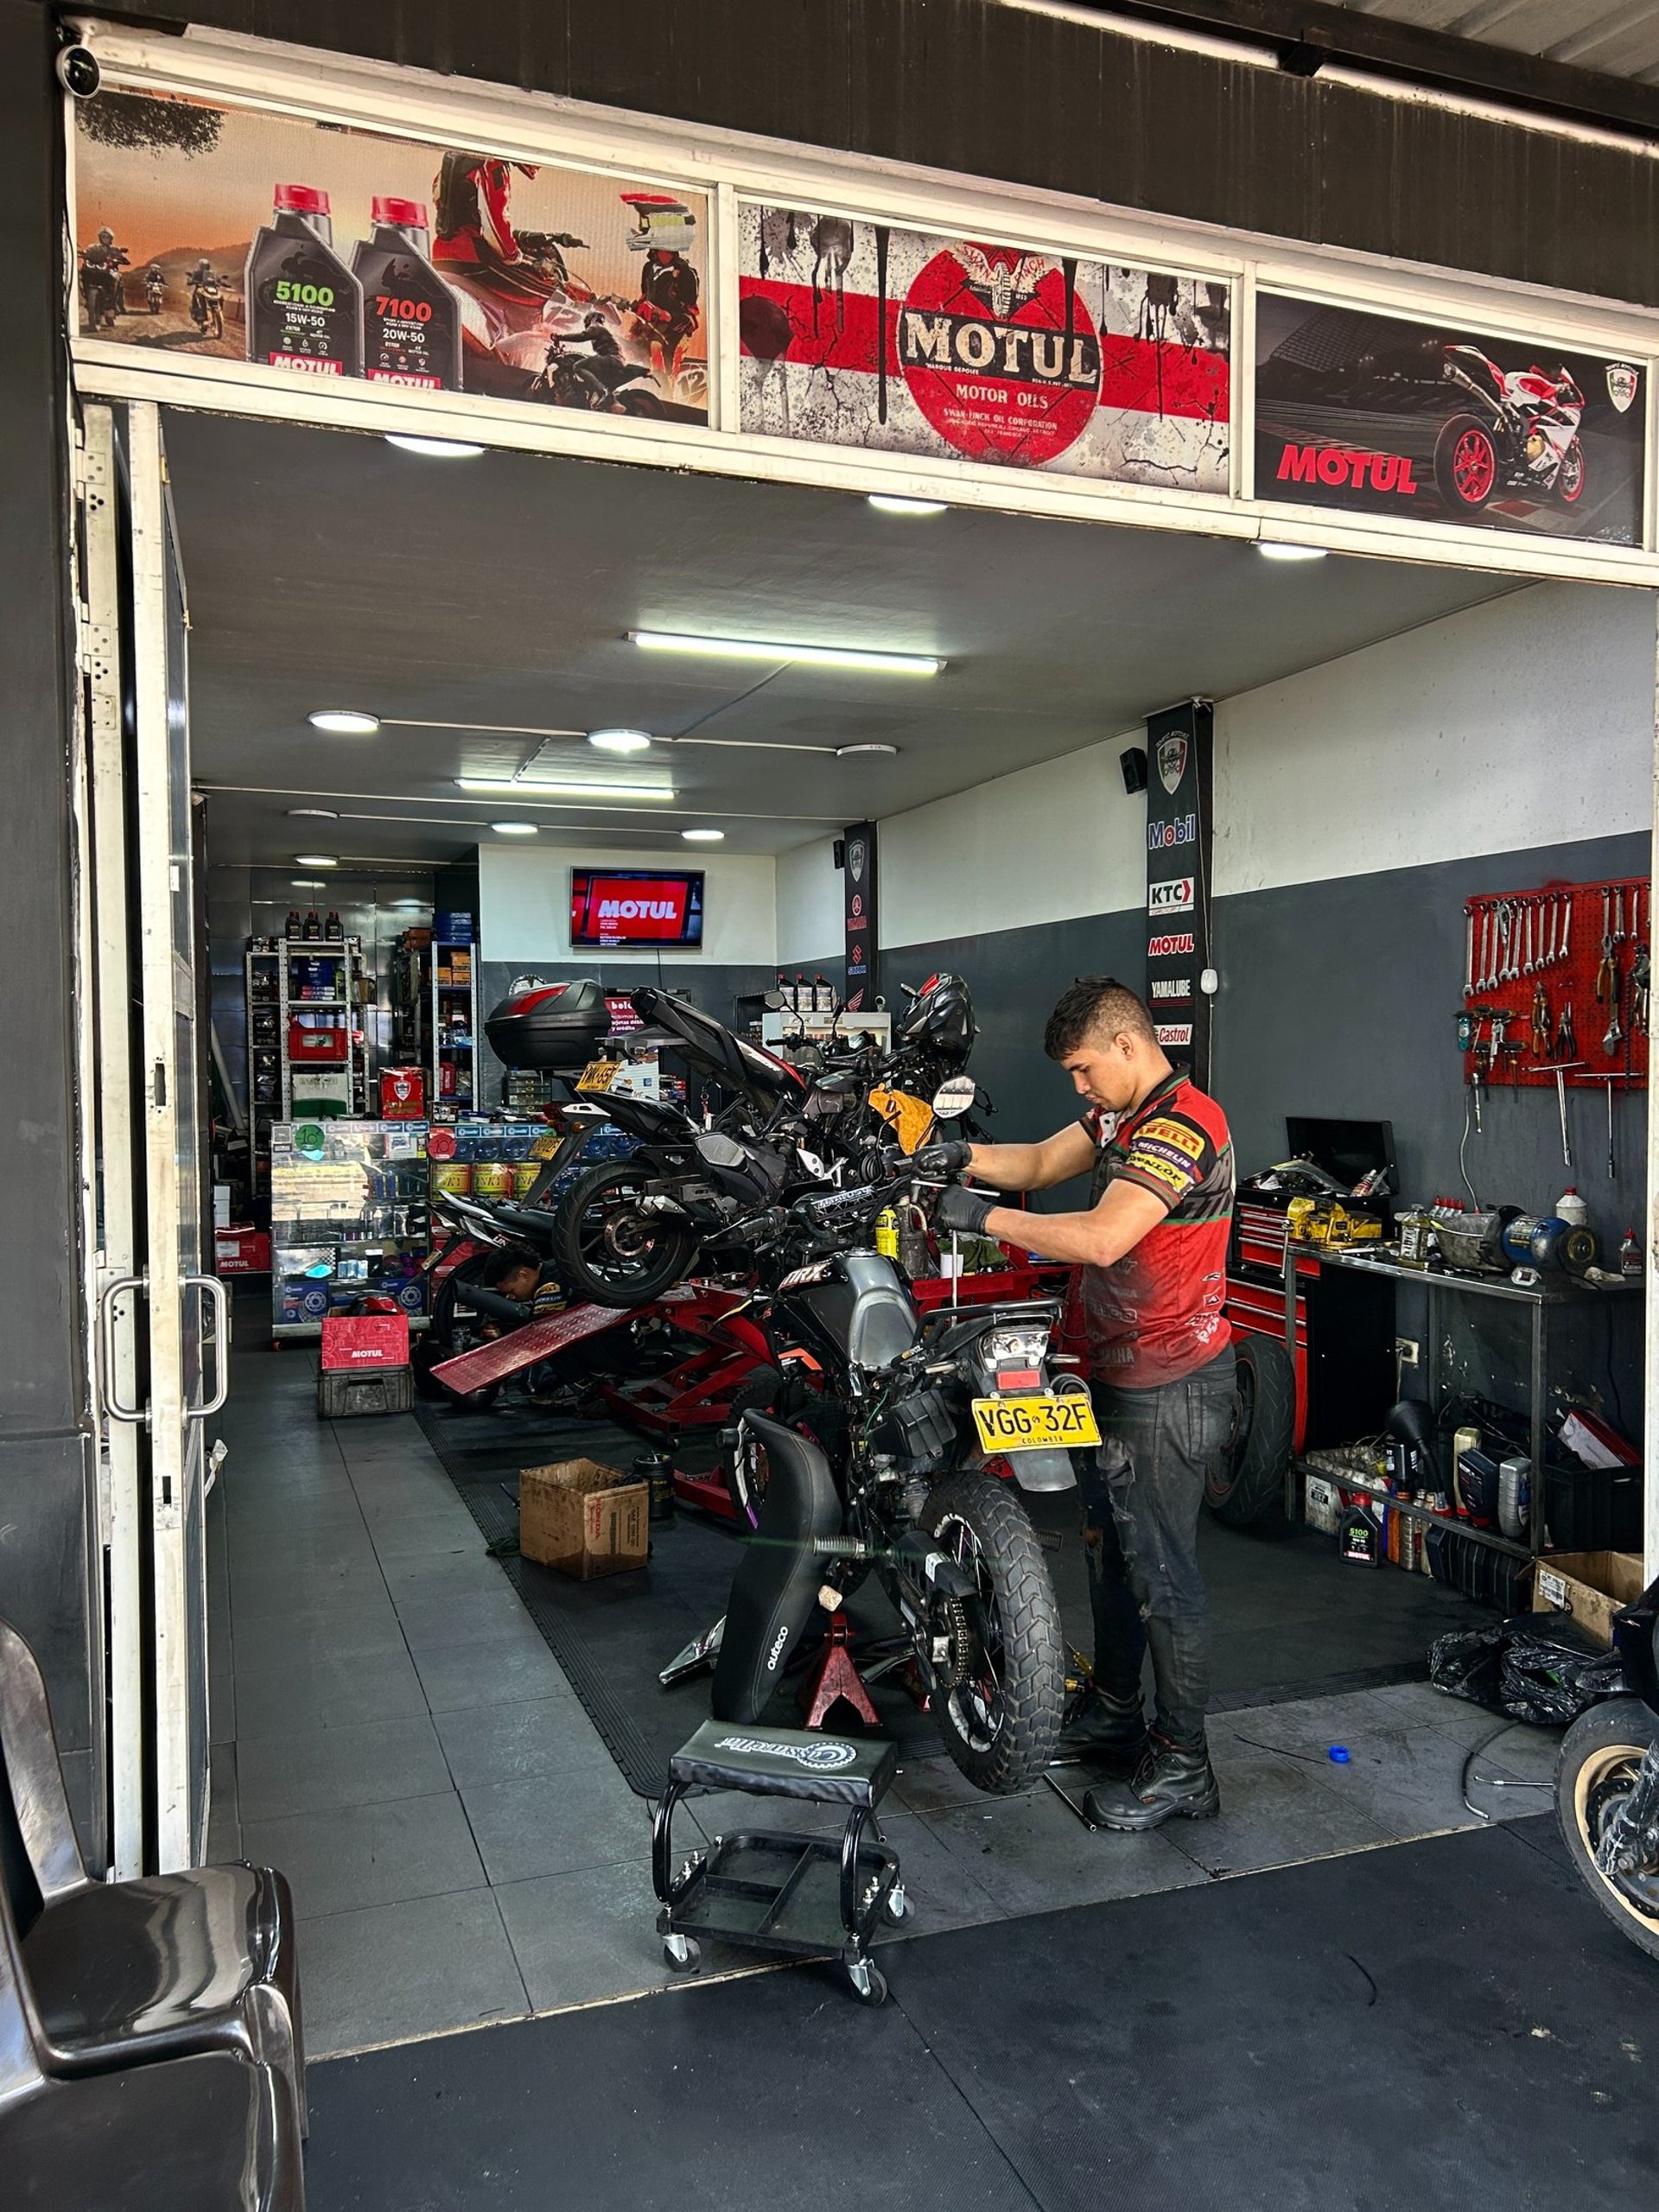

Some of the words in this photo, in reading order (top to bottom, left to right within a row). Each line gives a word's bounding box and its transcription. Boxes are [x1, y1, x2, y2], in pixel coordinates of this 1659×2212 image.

[963, 246, 991, 279] SWAN
[276, 280, 334, 307] 5100
[285, 312, 326, 327] 15W-50
[376, 296, 432, 322] 7100
[383, 327, 426, 344] 20W-50
[904, 312, 1098, 385] MOTUL
[274, 355, 340, 378] MOTUL
[956, 384, 1008, 404] MOTOR
[1017, 391, 1049, 410] OILS
[993, 415, 1005, 424] OIL
[1007, 416, 1058, 431] CORPORATION
[1276, 443, 1418, 495] MOTUL
[1148, 813, 1196, 850] Mobil
[1151, 883, 1184, 905] KTC
[598, 899, 677, 919] MOTUL
[1148, 933, 1195, 957] MOTUL
[1151, 978, 1191, 999] YAMALUBE
[1159, 1027, 1190, 1043] Castrol
[1138, 1126, 1198, 1154] IRELLI
[1138, 1141, 1192, 1168] MICHELIN
[1129, 1155, 1182, 1181] DUNLOP
[220, 1260, 250, 1268] MOTUL
[351, 1349, 384, 1358] MOTUL
[1021, 1435, 1065, 1446] COLOMBIA
[1349, 1527, 1370, 1538] 5100
[767, 1625, 789, 1671] auteco
